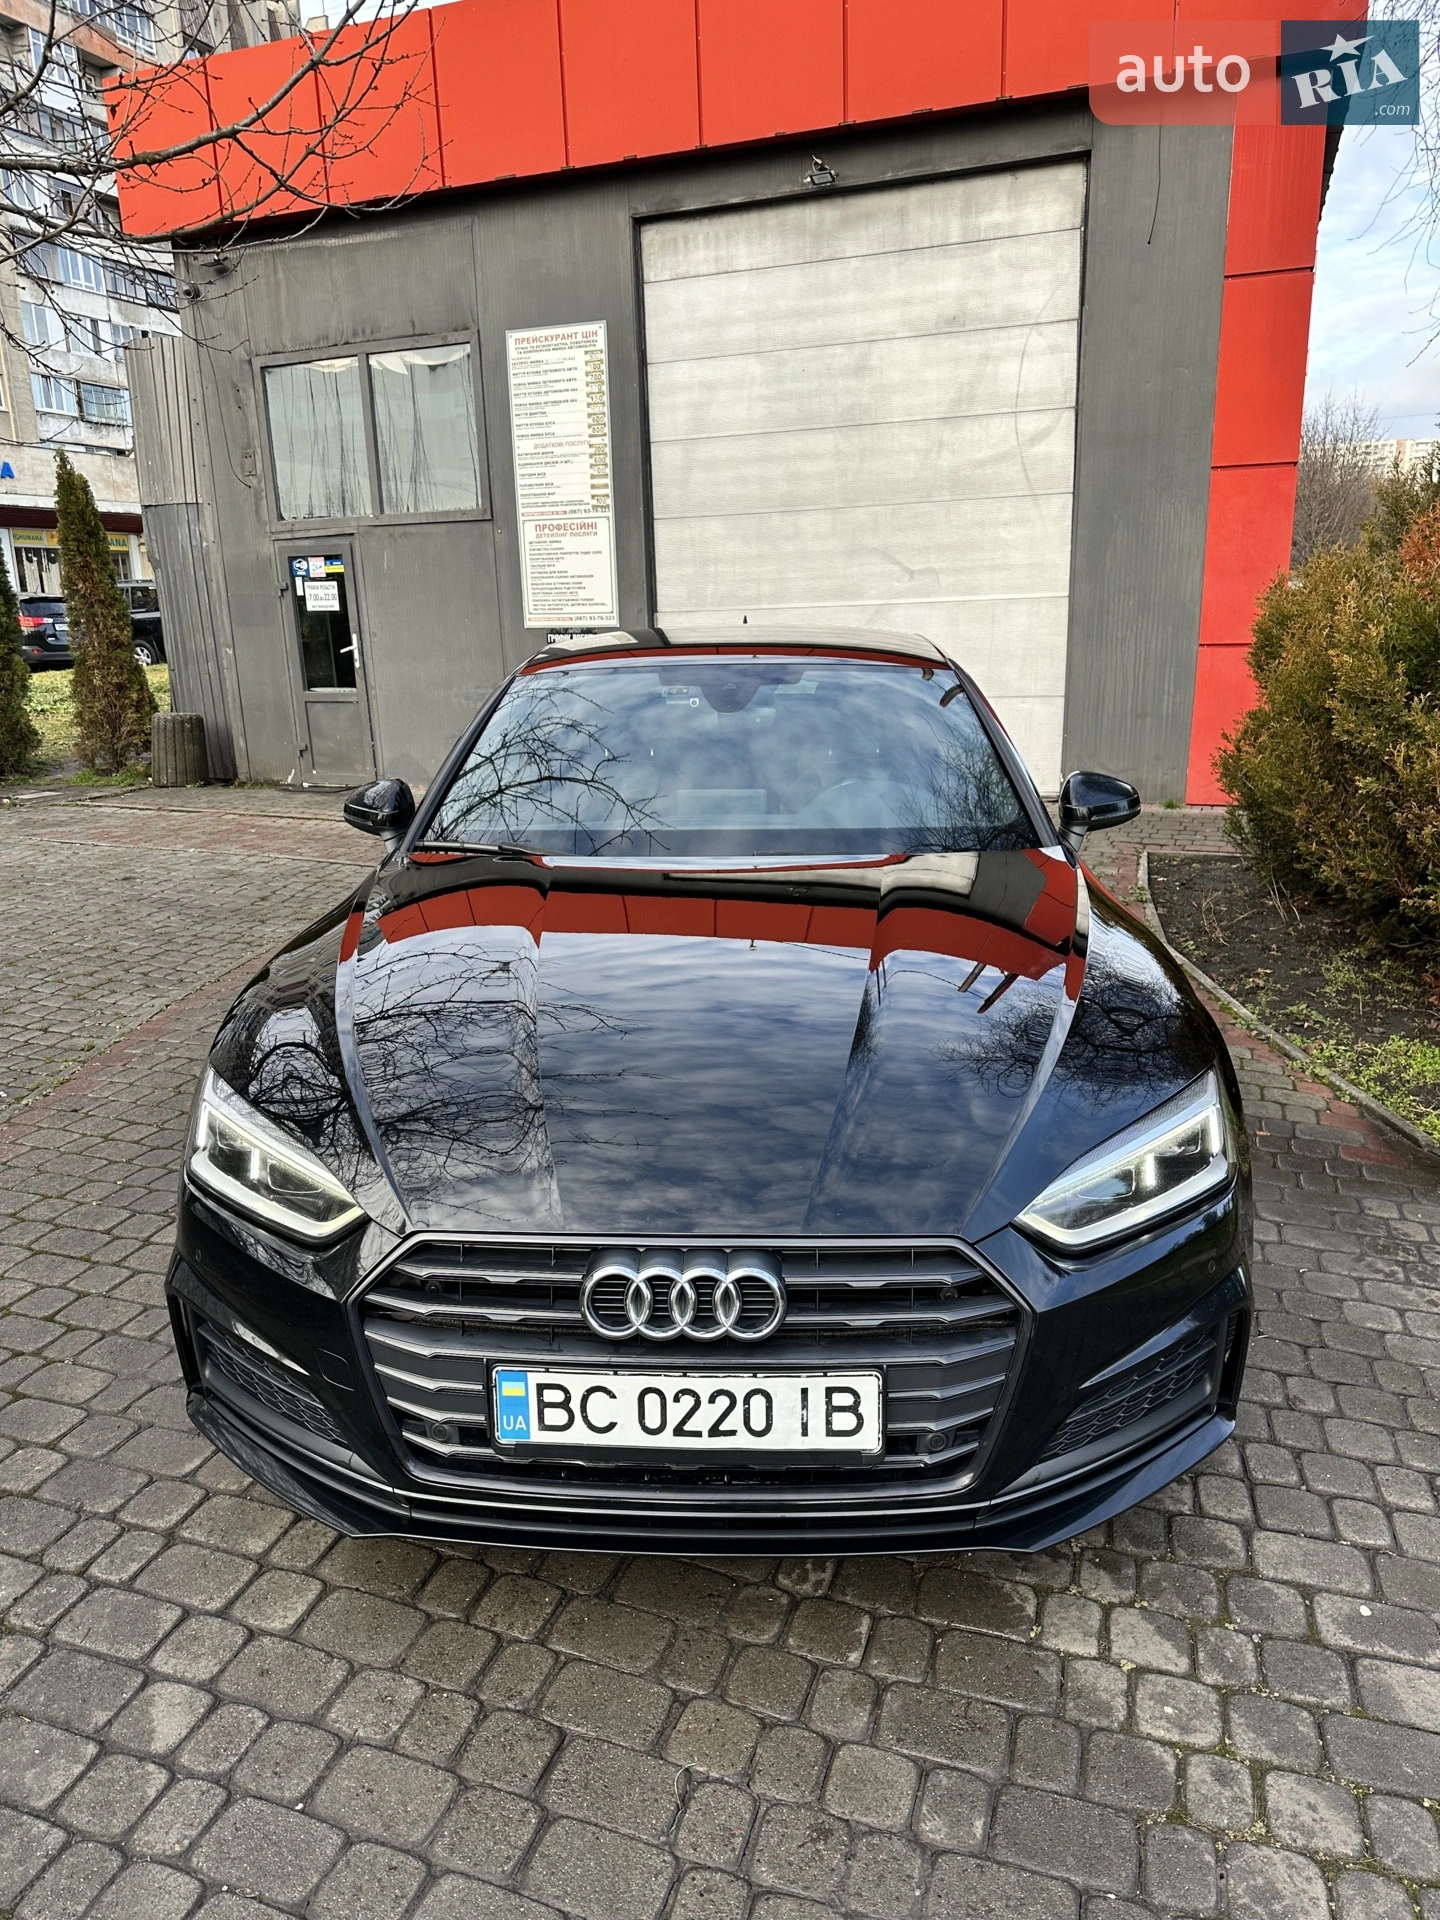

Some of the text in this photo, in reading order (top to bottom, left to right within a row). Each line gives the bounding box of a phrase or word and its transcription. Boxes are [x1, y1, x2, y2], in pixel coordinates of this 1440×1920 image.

[514, 330, 598, 346] ПРЕЙСКУРАНТ ЦІН
[535, 521, 597, 532] ПРОФЕСІЙНІ
[535, 1382, 864, 1438] BC 0220 IB
[503, 1415, 527, 1431] UA
